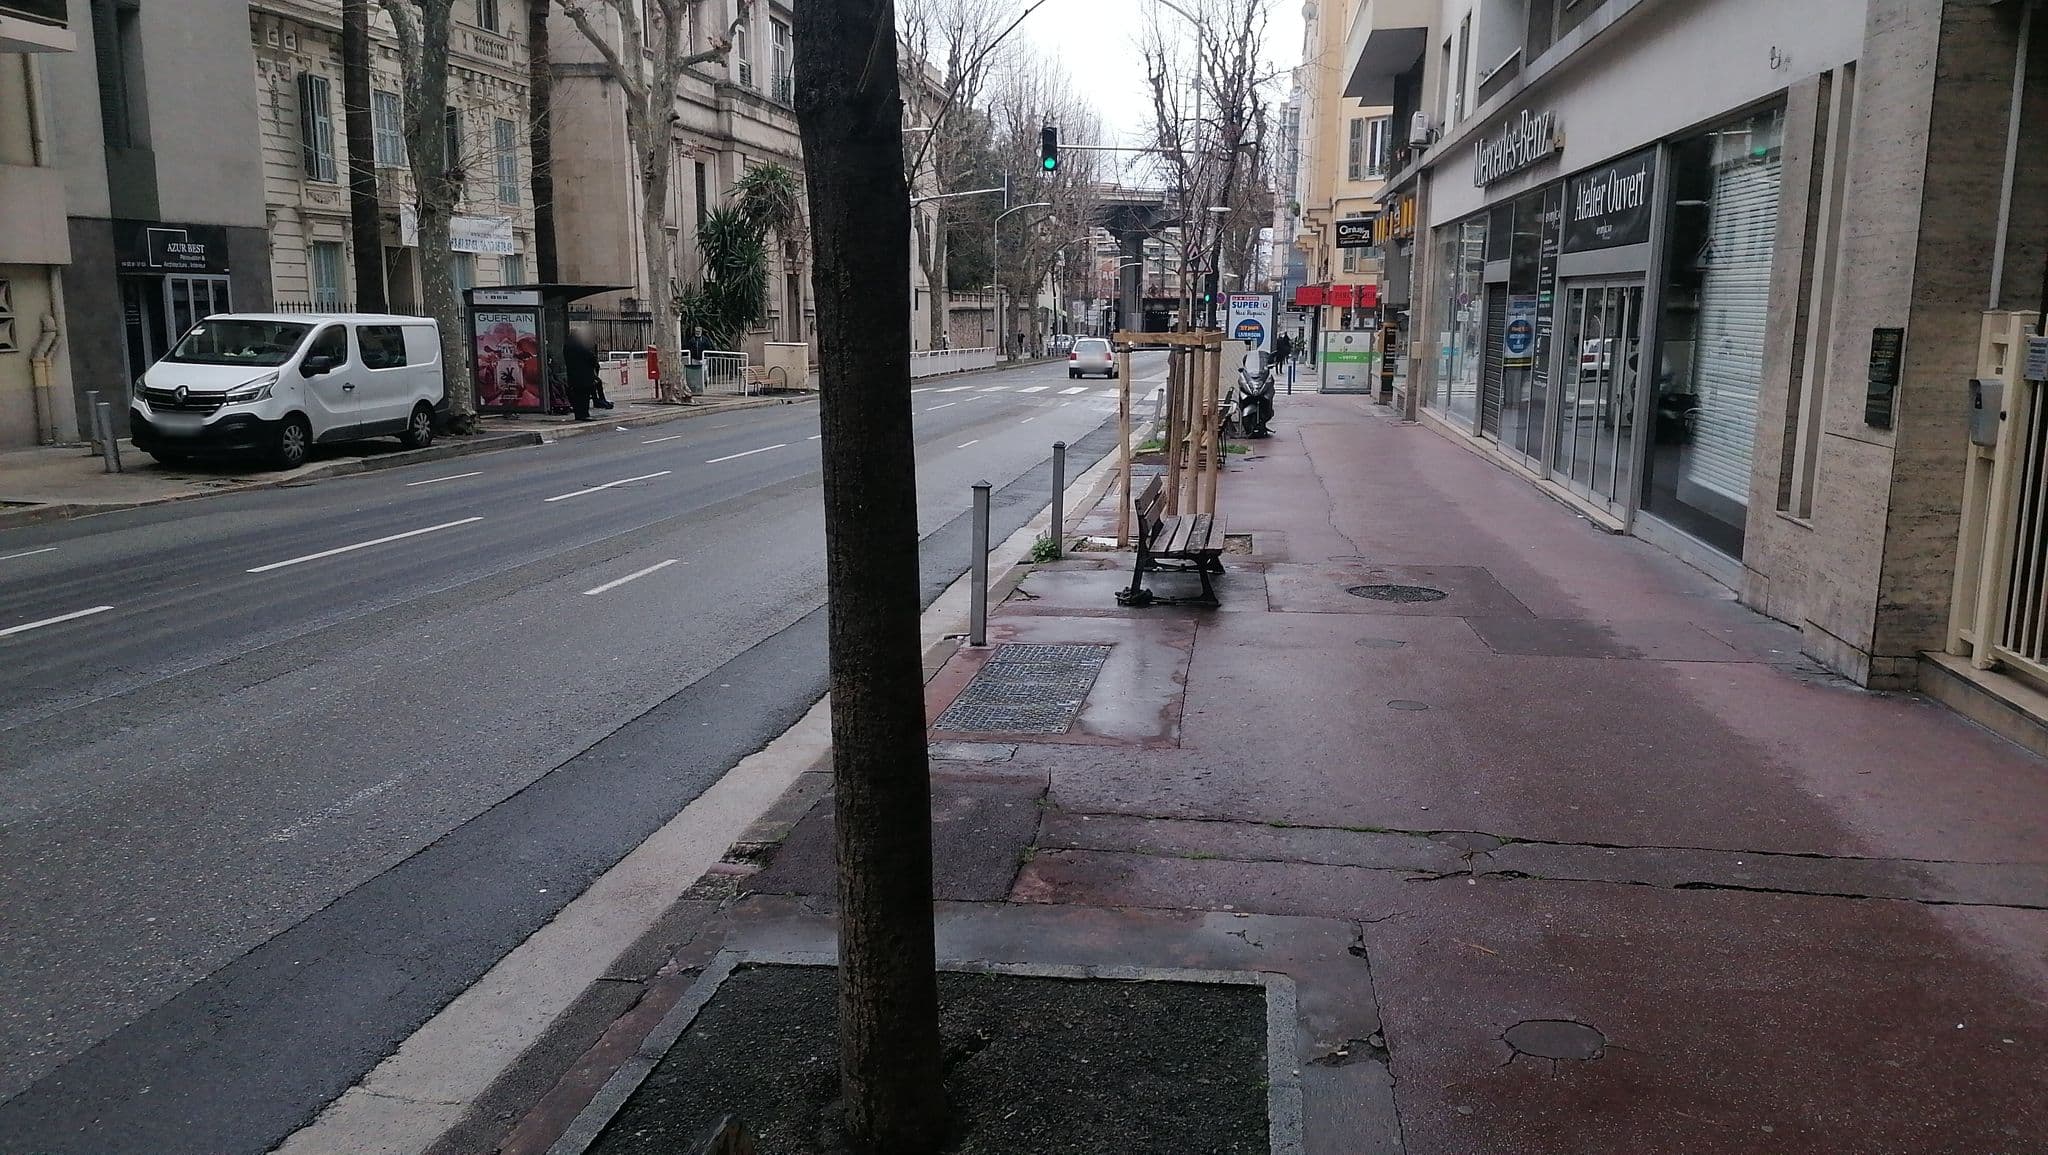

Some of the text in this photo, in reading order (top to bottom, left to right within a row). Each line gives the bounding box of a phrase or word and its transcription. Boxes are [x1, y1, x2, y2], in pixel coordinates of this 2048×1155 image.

[1473, 109, 1550, 187] Mercedes-Benz
[1574, 174, 1606, 222] Atelier
[1607, 161, 1647, 214] Ouvert
[1362, 229, 1370, 239] 21
[167, 243, 205, 254] AZUR BEST
[1231, 301, 1259, 309] SUPER
[478, 313, 533, 323] GUERLAIN
